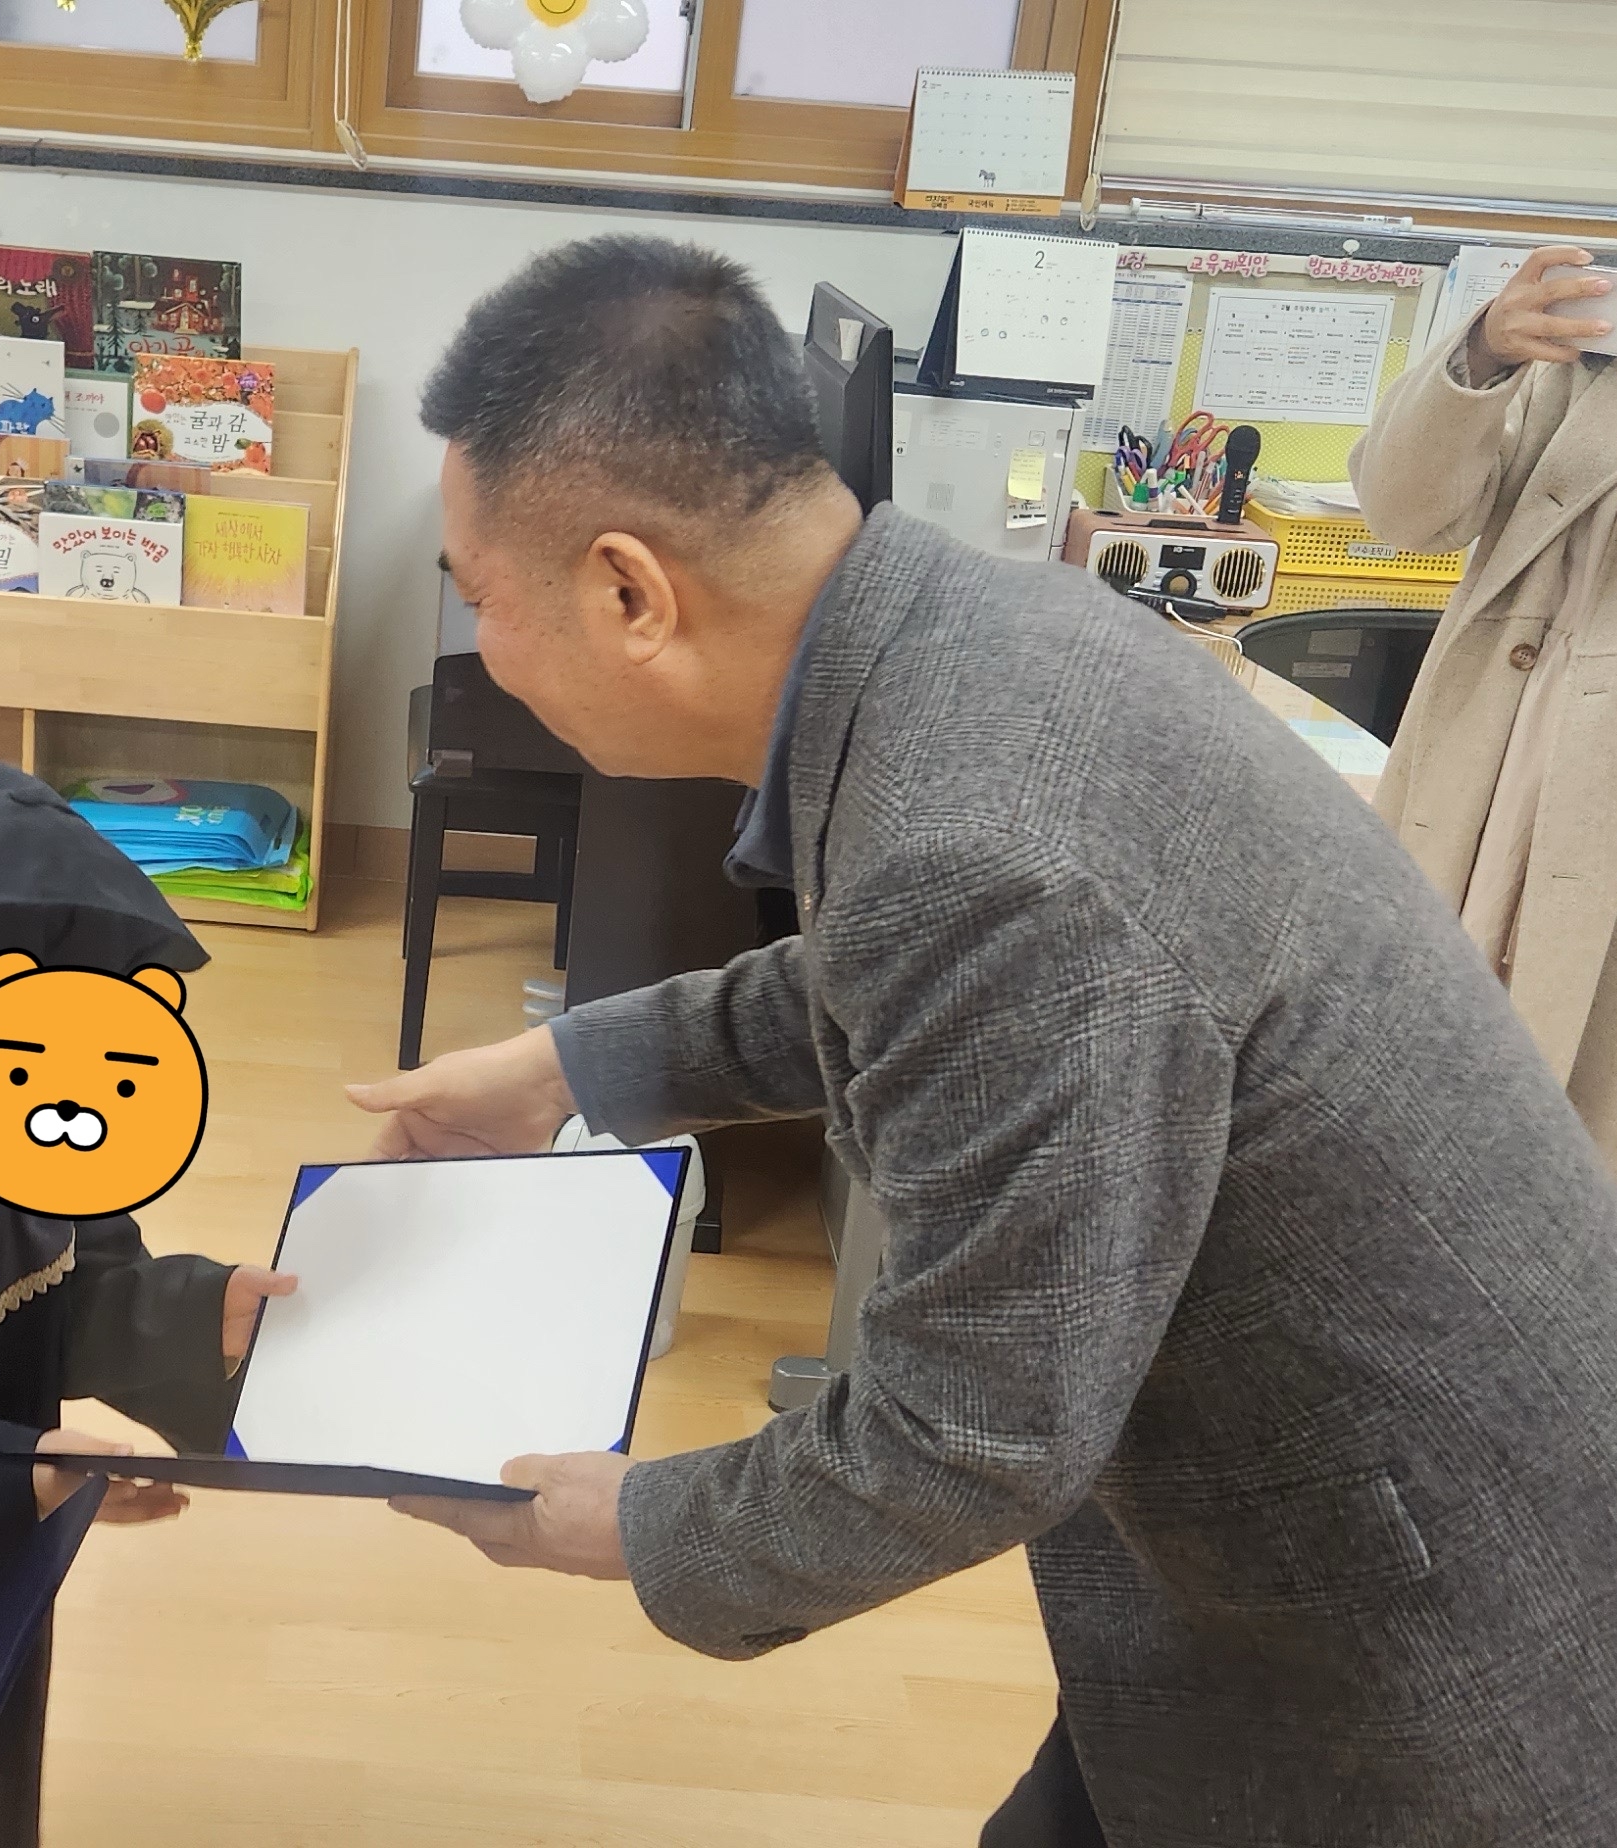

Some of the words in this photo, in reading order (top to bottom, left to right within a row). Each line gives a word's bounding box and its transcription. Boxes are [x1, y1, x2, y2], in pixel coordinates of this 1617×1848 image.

[1034, 250, 1045, 269] 2
[1190, 253, 1270, 276] 교육계획안
[1309, 256, 1423, 285] 방과후과정계획안
[17, 278, 58, 298] 노래
[190, 410, 223, 432] 귤과
[212, 433, 231, 453] 밤
[215, 520, 263, 541] 세상에서
[52, 529, 97, 554] 맛있어
[101, 526, 137, 546] 보이는
[140, 537, 169, 563] 백곰
[193, 541, 220, 560] 가장
[256, 543, 282, 565] 사자
